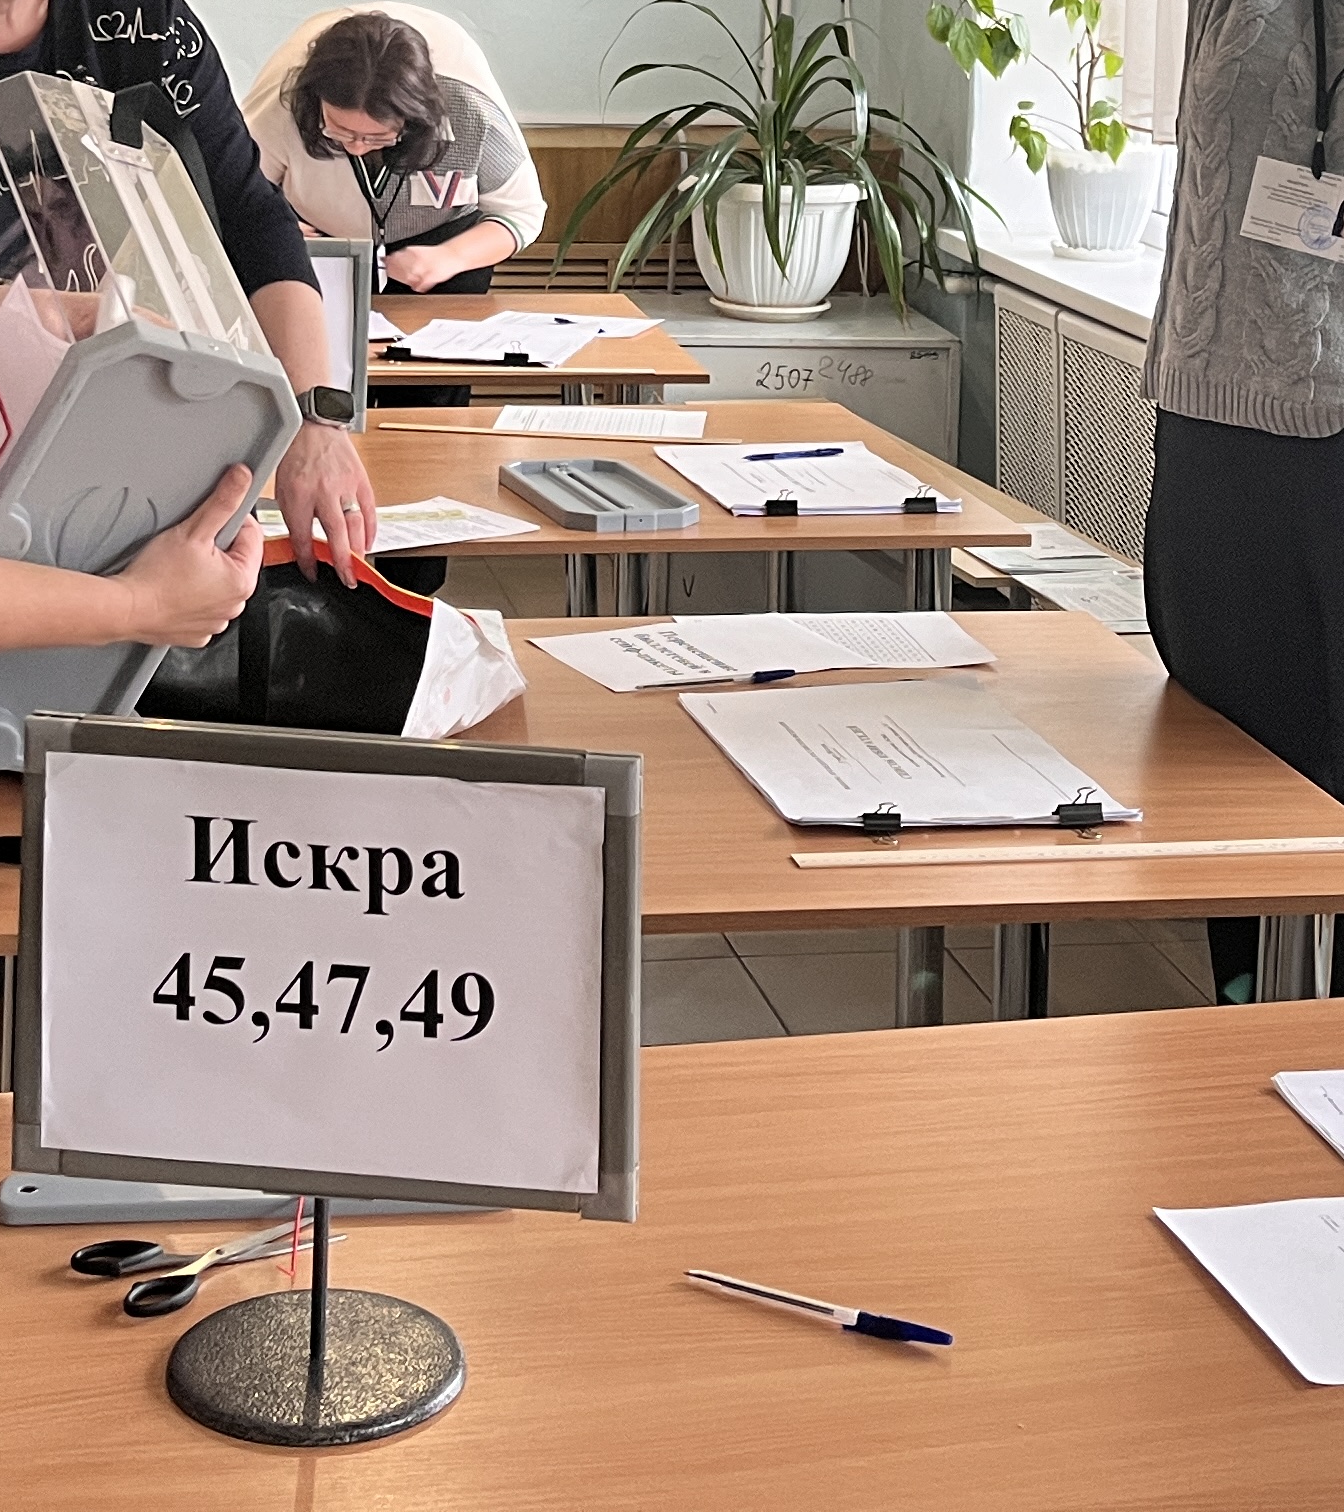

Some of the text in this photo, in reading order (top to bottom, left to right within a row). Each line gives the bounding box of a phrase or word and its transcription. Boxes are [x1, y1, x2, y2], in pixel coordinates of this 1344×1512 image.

[755, 361, 814, 392] 2507
[184, 814, 467, 916] Искра
[152, 952, 496, 1052] 45,47,49
